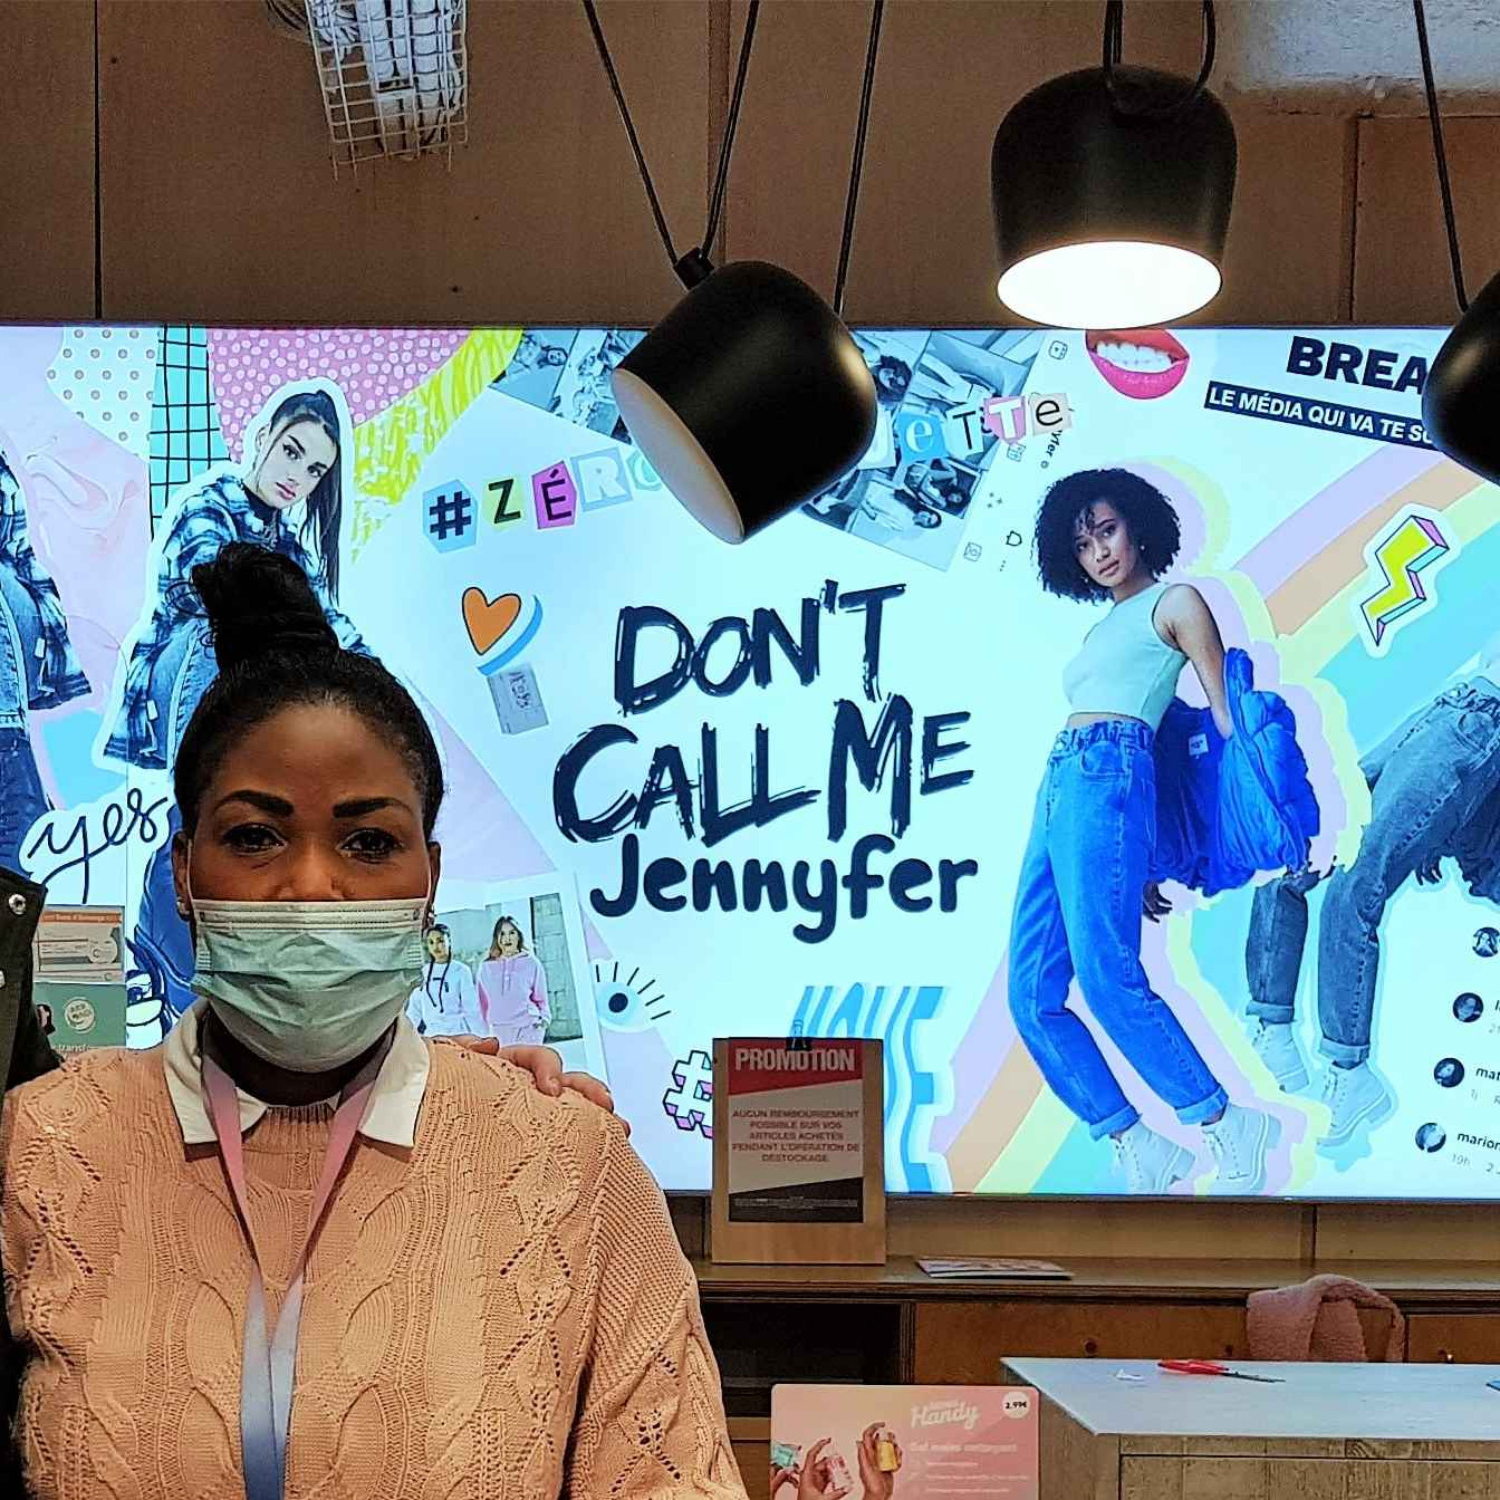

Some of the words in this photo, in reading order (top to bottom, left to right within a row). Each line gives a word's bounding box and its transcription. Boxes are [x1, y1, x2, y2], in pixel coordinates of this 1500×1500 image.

[1208, 386, 1236, 408] LE
[1239, 391, 1304, 420] MÉDIA
[1307, 404, 1347, 428] QUI
[1349, 411, 1375, 435] VA
[1379, 417, 1406, 440] TE
[612, 580, 907, 718] DON'T
[553, 723, 821, 848] CALL
[827, 692, 975, 842] ME
[26, 787, 169, 905] yes
[589, 833, 979, 944] Jennyfer
[734, 1047, 856, 1072] PROMOTION
[731, 1109, 768, 1118] AUCUN
[770, 1109, 859, 1118] REMBOURSEMENT
[749, 1120, 797, 1129] POSSIBLE
[799, 1120, 820, 1129] SUR
[822, 1120, 842, 1129] VOS
[731, 1143, 778, 1151] PENDANT
[846, 1143, 859, 1152] DE
[749, 1132, 796, 1140] ARTICLES
[910, 1401, 978, 1430] Handy
